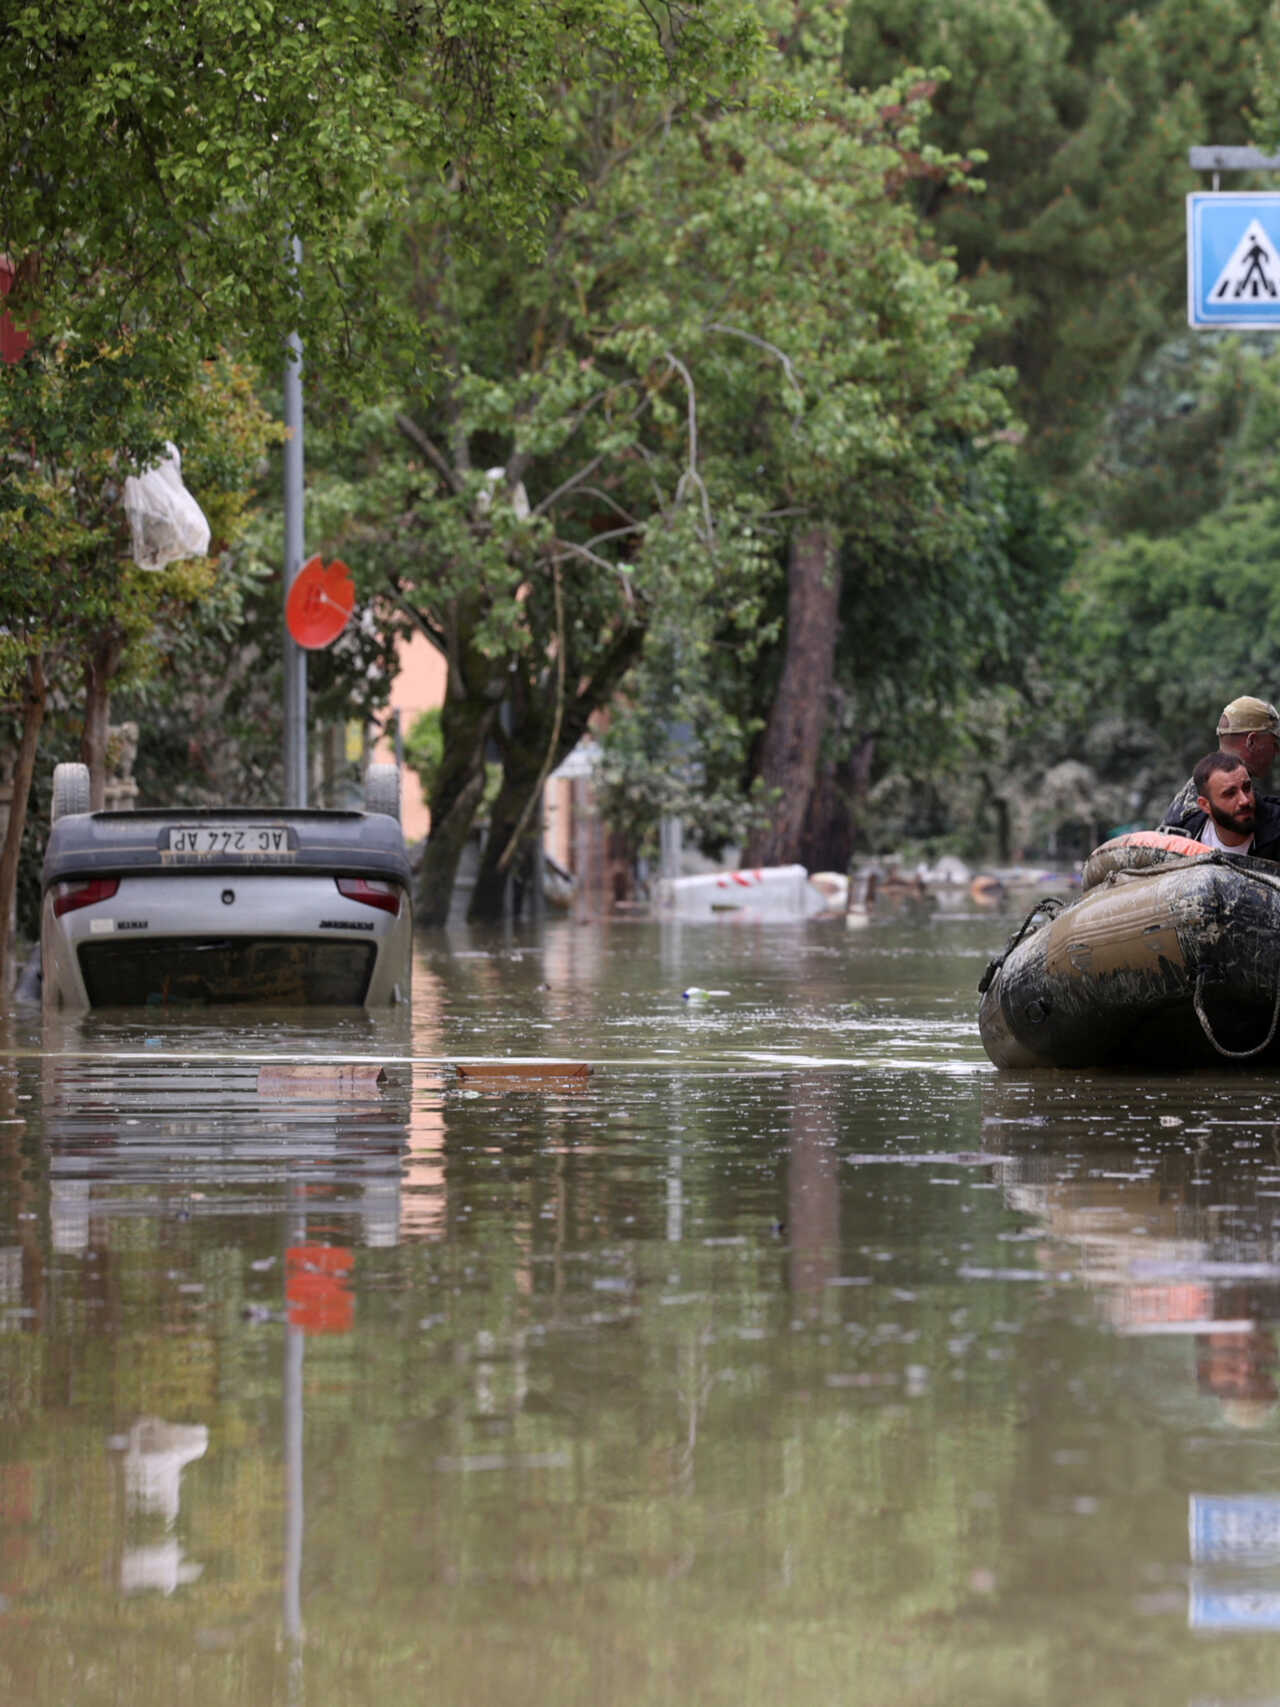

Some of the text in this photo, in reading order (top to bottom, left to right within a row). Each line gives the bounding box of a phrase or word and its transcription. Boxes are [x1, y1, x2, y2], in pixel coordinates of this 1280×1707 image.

[174, 831, 283, 851] AG 244 AP
